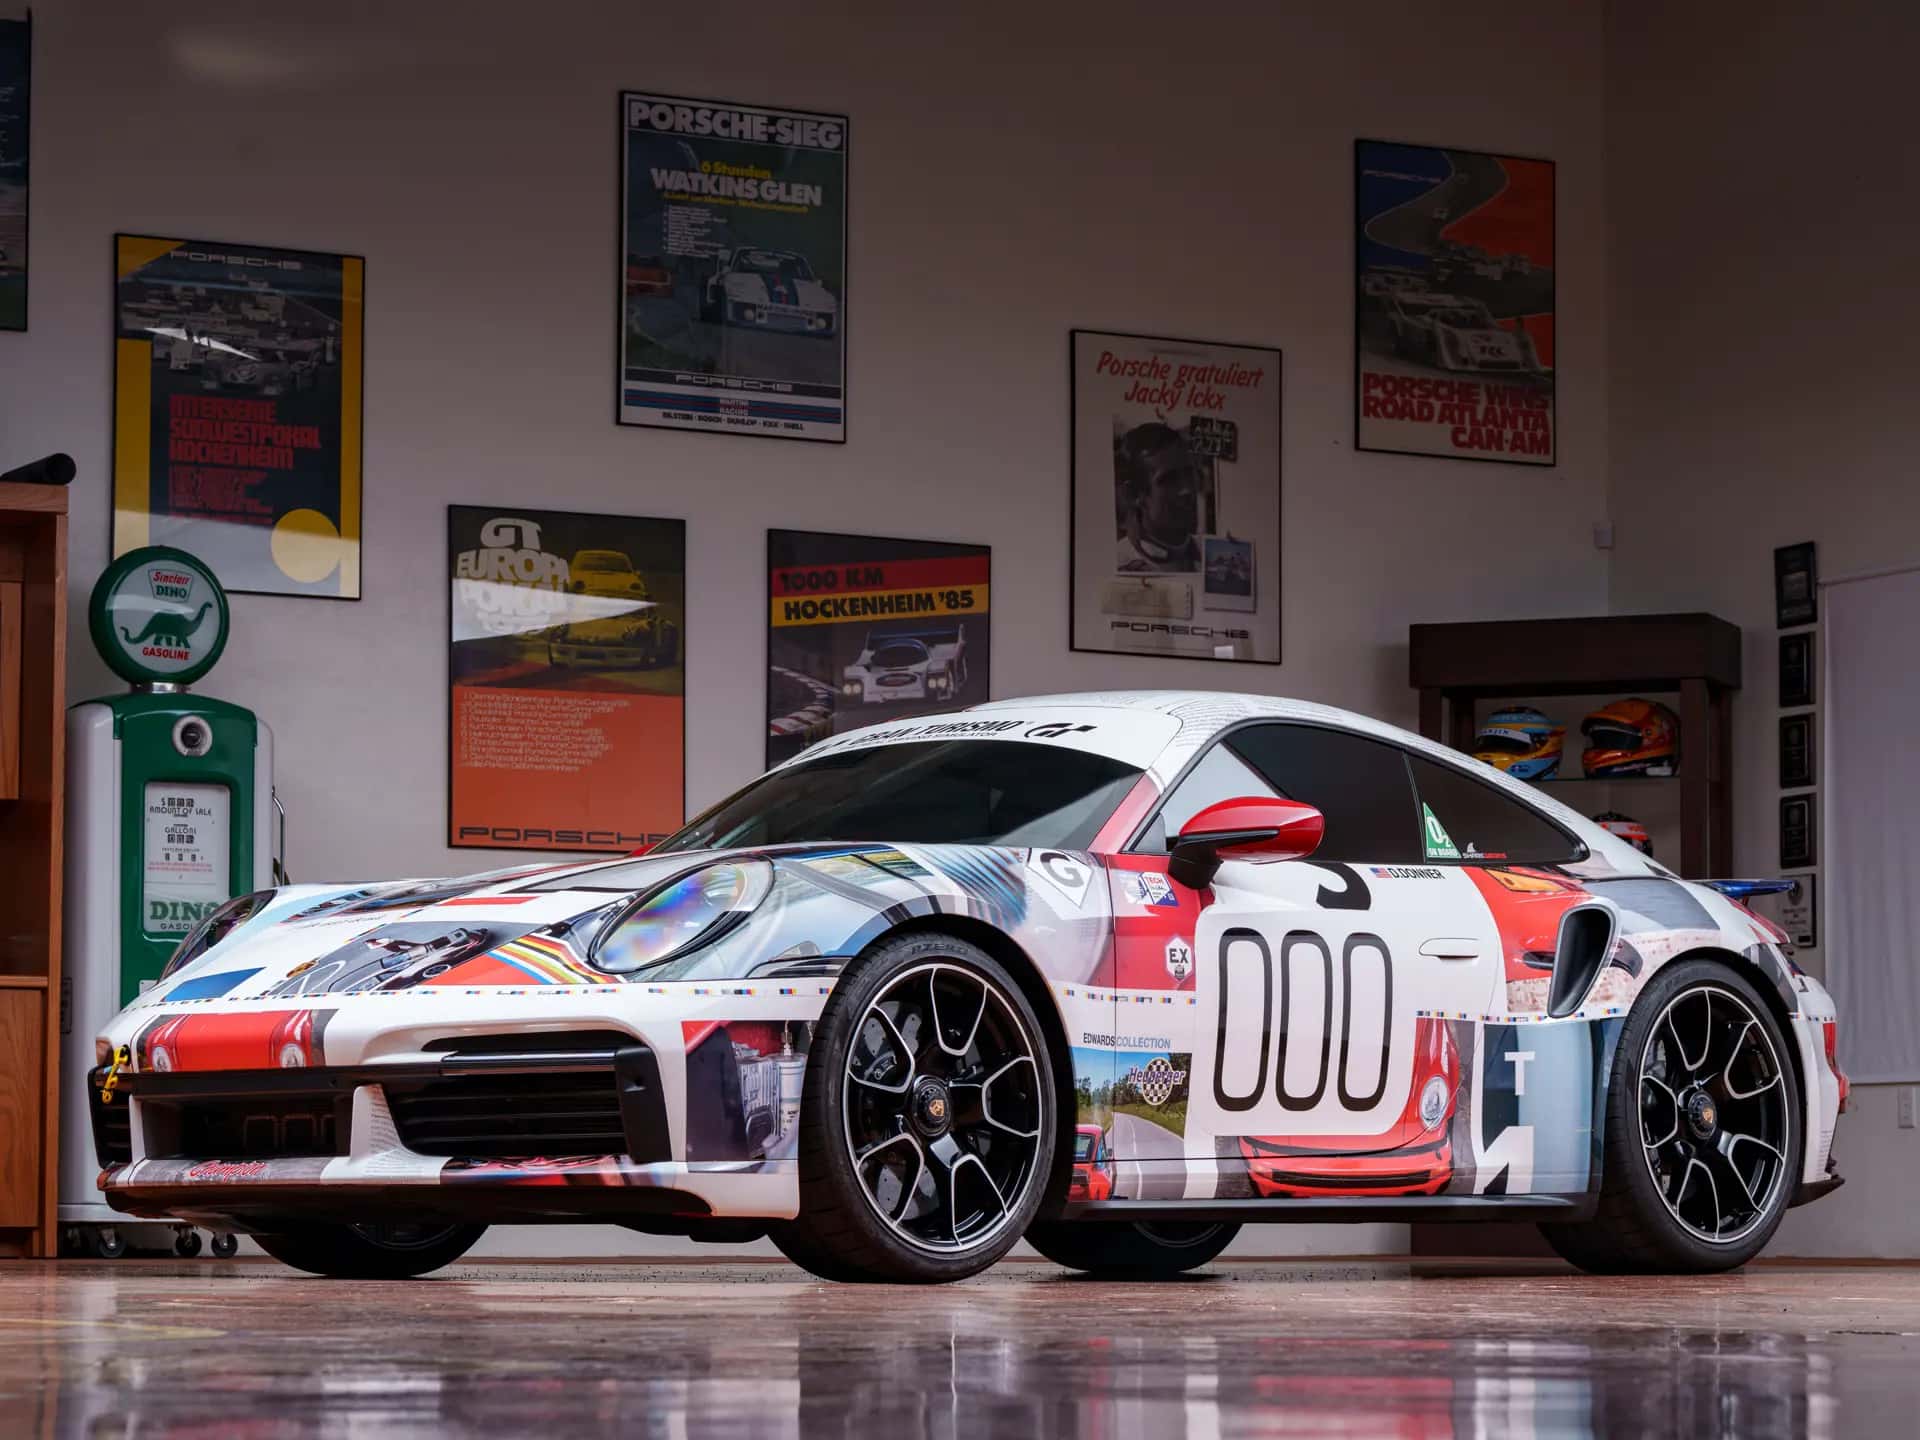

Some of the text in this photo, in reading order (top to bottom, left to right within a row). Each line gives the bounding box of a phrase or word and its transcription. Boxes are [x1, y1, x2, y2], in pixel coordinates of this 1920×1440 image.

[629, 101, 842, 149] PORSCHE-SIEG
[651, 167, 758, 201] WATKINS
[760, 180, 823, 207] GLEN
[169, 250, 304, 270] PORSCHE
[1096, 351, 1265, 389] Porsche gratuliert
[674, 374, 793, 393] PORSCHE
[1124, 380, 1227, 411] Jacky Ickx
[1363, 372, 1481, 405] PORSCHE
[1363, 396, 1550, 432] ROAD ATLANTA
[480, 517, 543, 551] GT
[153, 571, 190, 585] Sinclair
[780, 567, 884, 591] 1000 KM
[156, 585, 187, 599] DINO
[784, 592, 935, 621] HOCKENHEIM
[1111, 621, 1249, 639] PORSCHE
[142, 646, 190, 661] GASOLINE
[1169, 948, 1189, 964] EX
[1213, 926, 1393, 1112] 000
[1128, 1066, 1186, 1087] Heuberger
